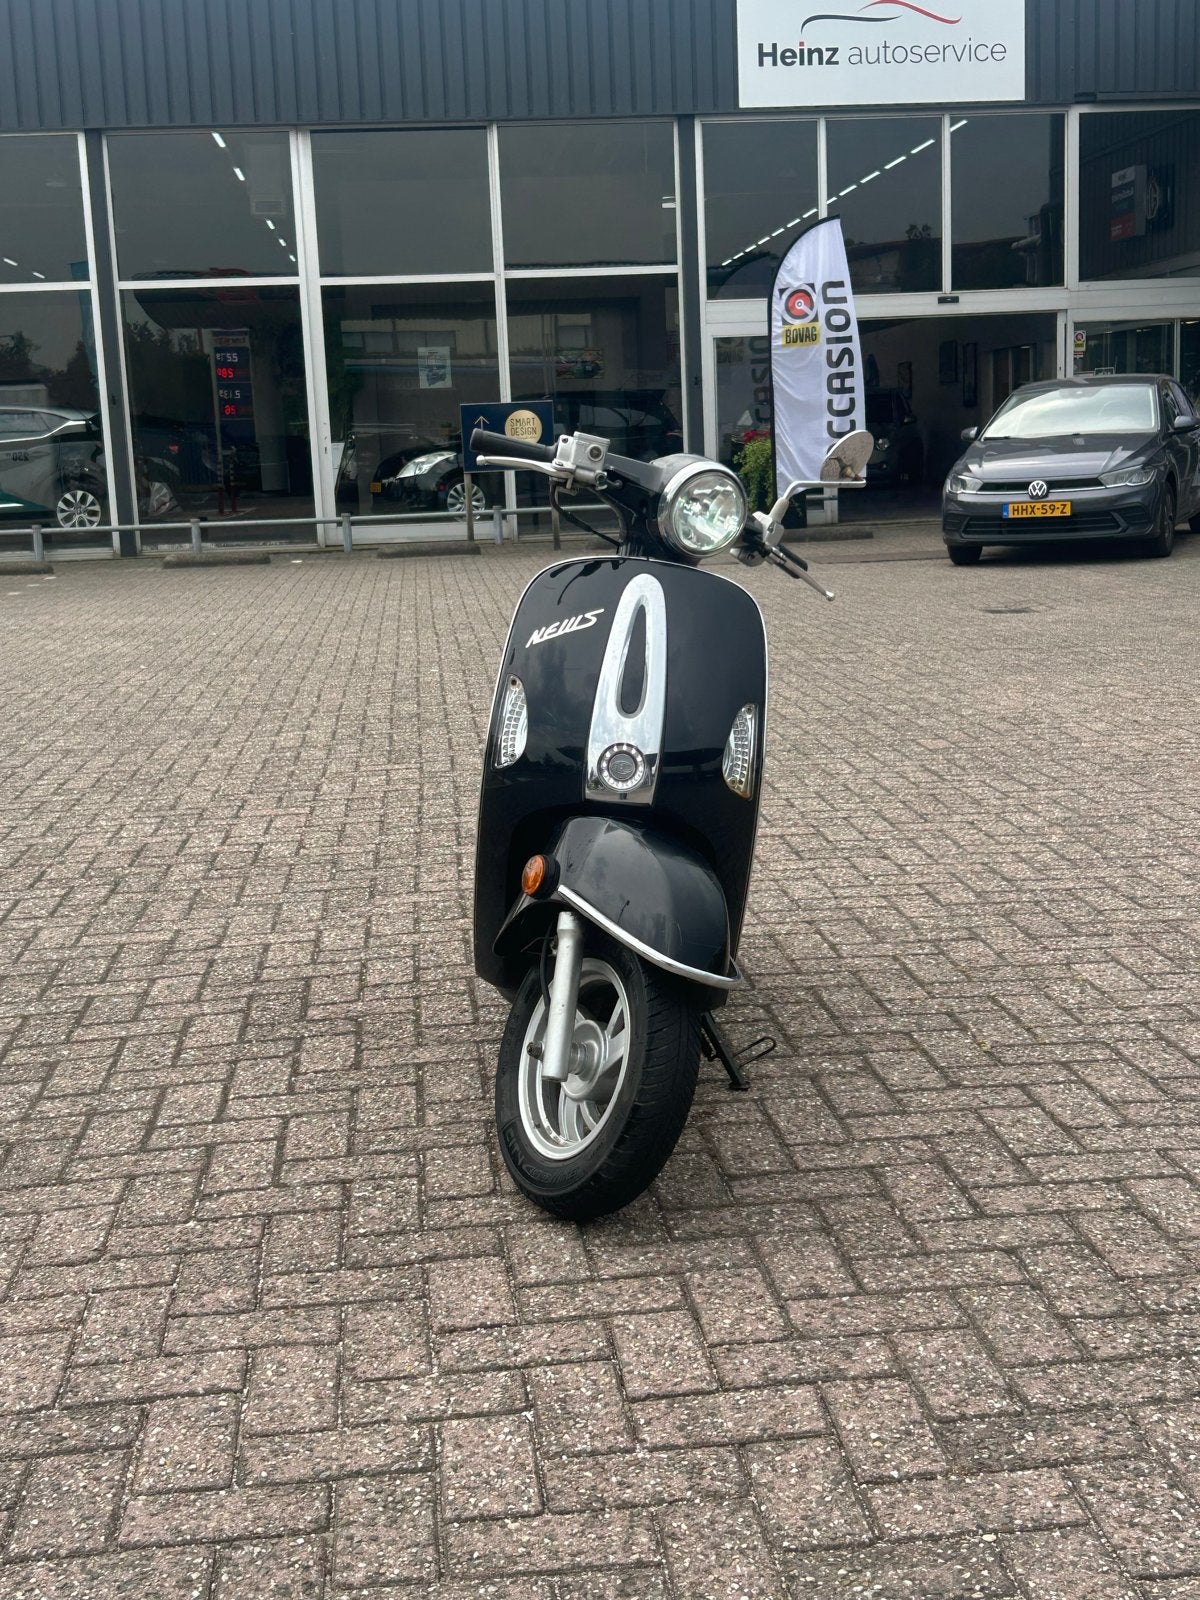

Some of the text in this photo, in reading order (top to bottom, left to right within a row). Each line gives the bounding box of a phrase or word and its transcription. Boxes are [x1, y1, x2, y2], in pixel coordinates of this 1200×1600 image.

[757, 37, 1007, 67] Heinz autoservice
[785, 325, 818, 345] BOVAG
[821, 280, 857, 455] CCASION
[510, 417, 536, 428] SMART
[510, 427, 537, 437] DESIGN
[1012, 503, 1068, 516] HHX-59-Z
